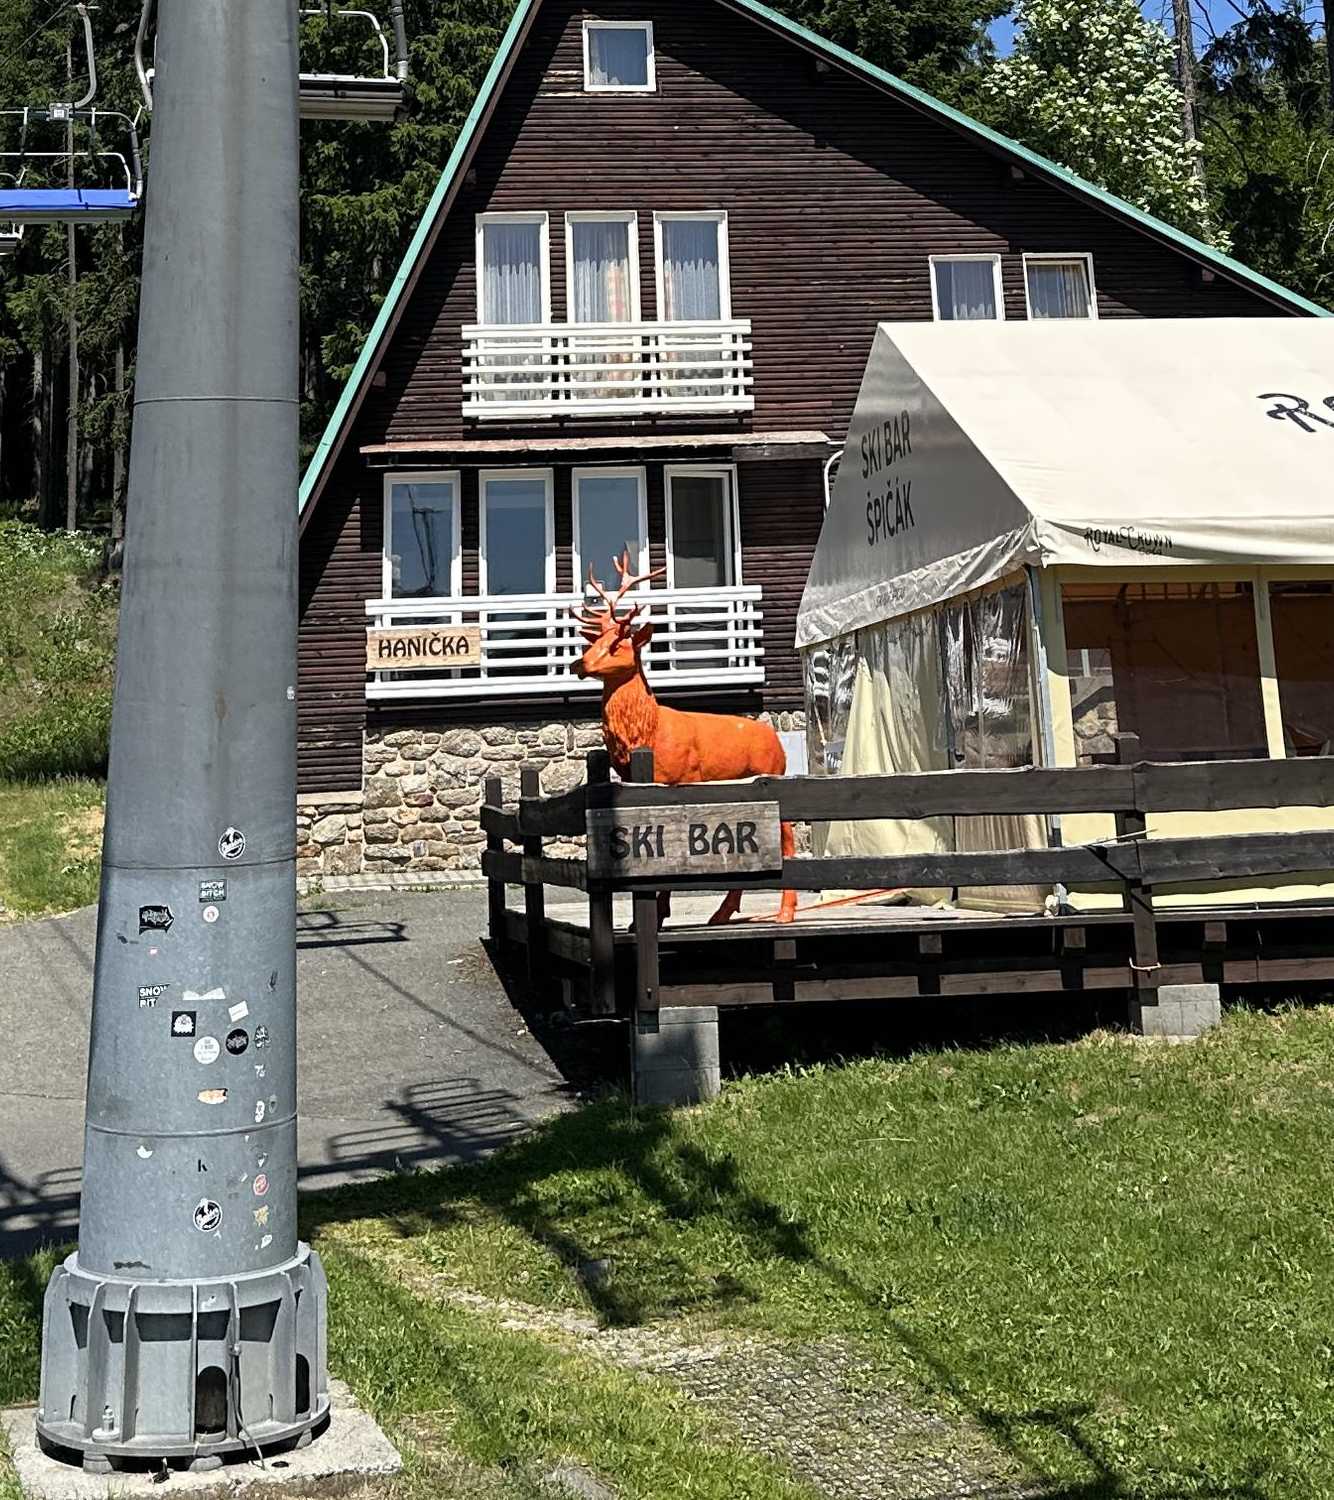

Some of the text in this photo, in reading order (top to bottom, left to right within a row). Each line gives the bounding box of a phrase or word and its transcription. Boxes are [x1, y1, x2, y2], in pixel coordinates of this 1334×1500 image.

[861, 409, 912, 479] SKI BAR
[866, 476, 915, 547] ŠPIČÁK
[378, 631, 469, 659] HANIČKA
[608, 820, 760, 860] SKI BAR
